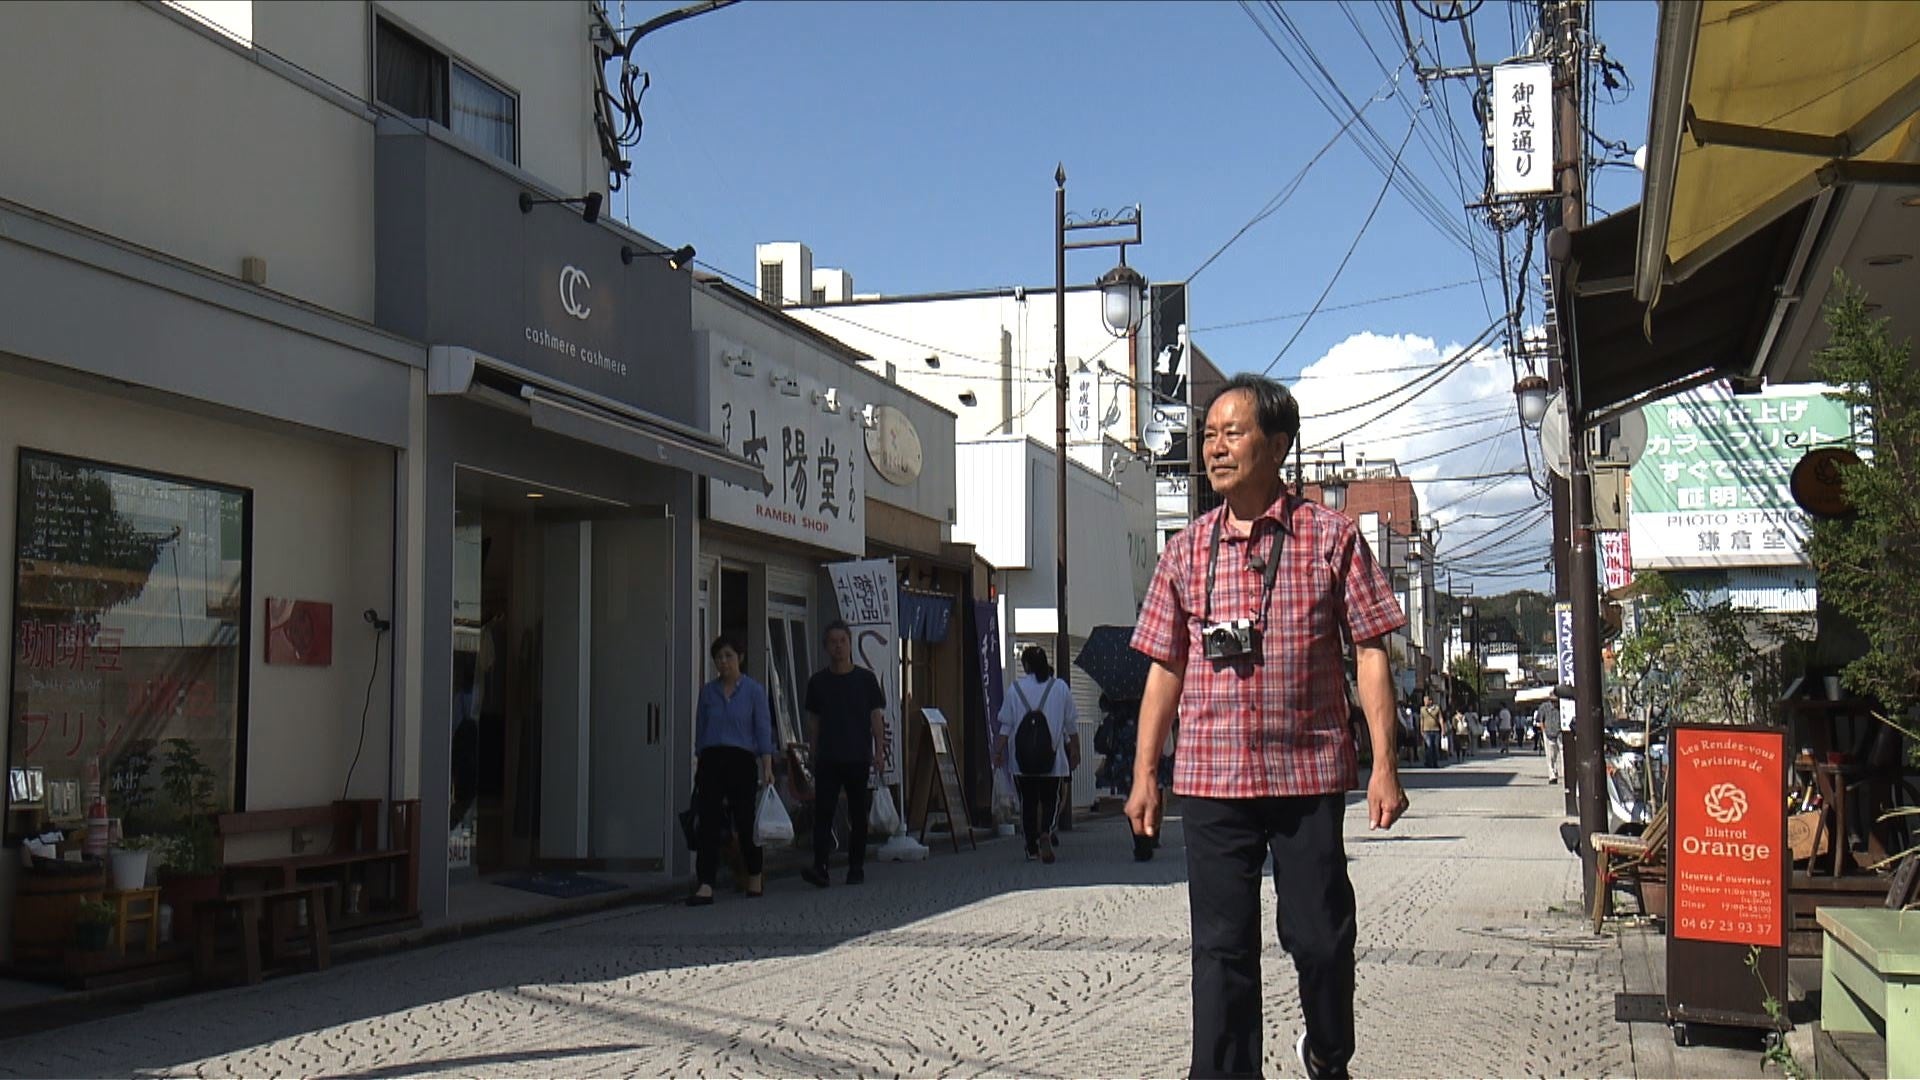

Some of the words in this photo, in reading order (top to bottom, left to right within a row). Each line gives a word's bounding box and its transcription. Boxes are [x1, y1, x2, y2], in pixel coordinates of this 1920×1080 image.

[1511, 82, 1536, 178] 御成通り
[525, 325, 577, 359] cashmere
[580, 347, 628, 377] cashmere
[1078, 380, 1091, 432] 御成通り
[756, 504, 796, 526] RAMEN
[801, 517, 830, 534] SHOP
[1667, 514, 1728, 528] PHOTO
[1698, 529, 1787, 551] 鎌倉堂
[21, 617, 125, 673] 珈琲豆
[1680, 742, 1699, 757] Les
[1701, 738, 1776, 761] Rendez-vous
[1692, 756, 1747, 769] Parisiens
[1749, 760, 1764, 773] de
[1705, 826, 1748, 840] Bistrot
[1682, 836, 1771, 862] Orange
[1681, 870, 1714, 882] Heures
[1681, 918, 1696, 929] 04
[1700, 919, 1715, 930] 67
[1719, 920, 1733, 932] 23
[1738, 921, 1753, 933] 93
[1757, 923, 1772, 936] 37
